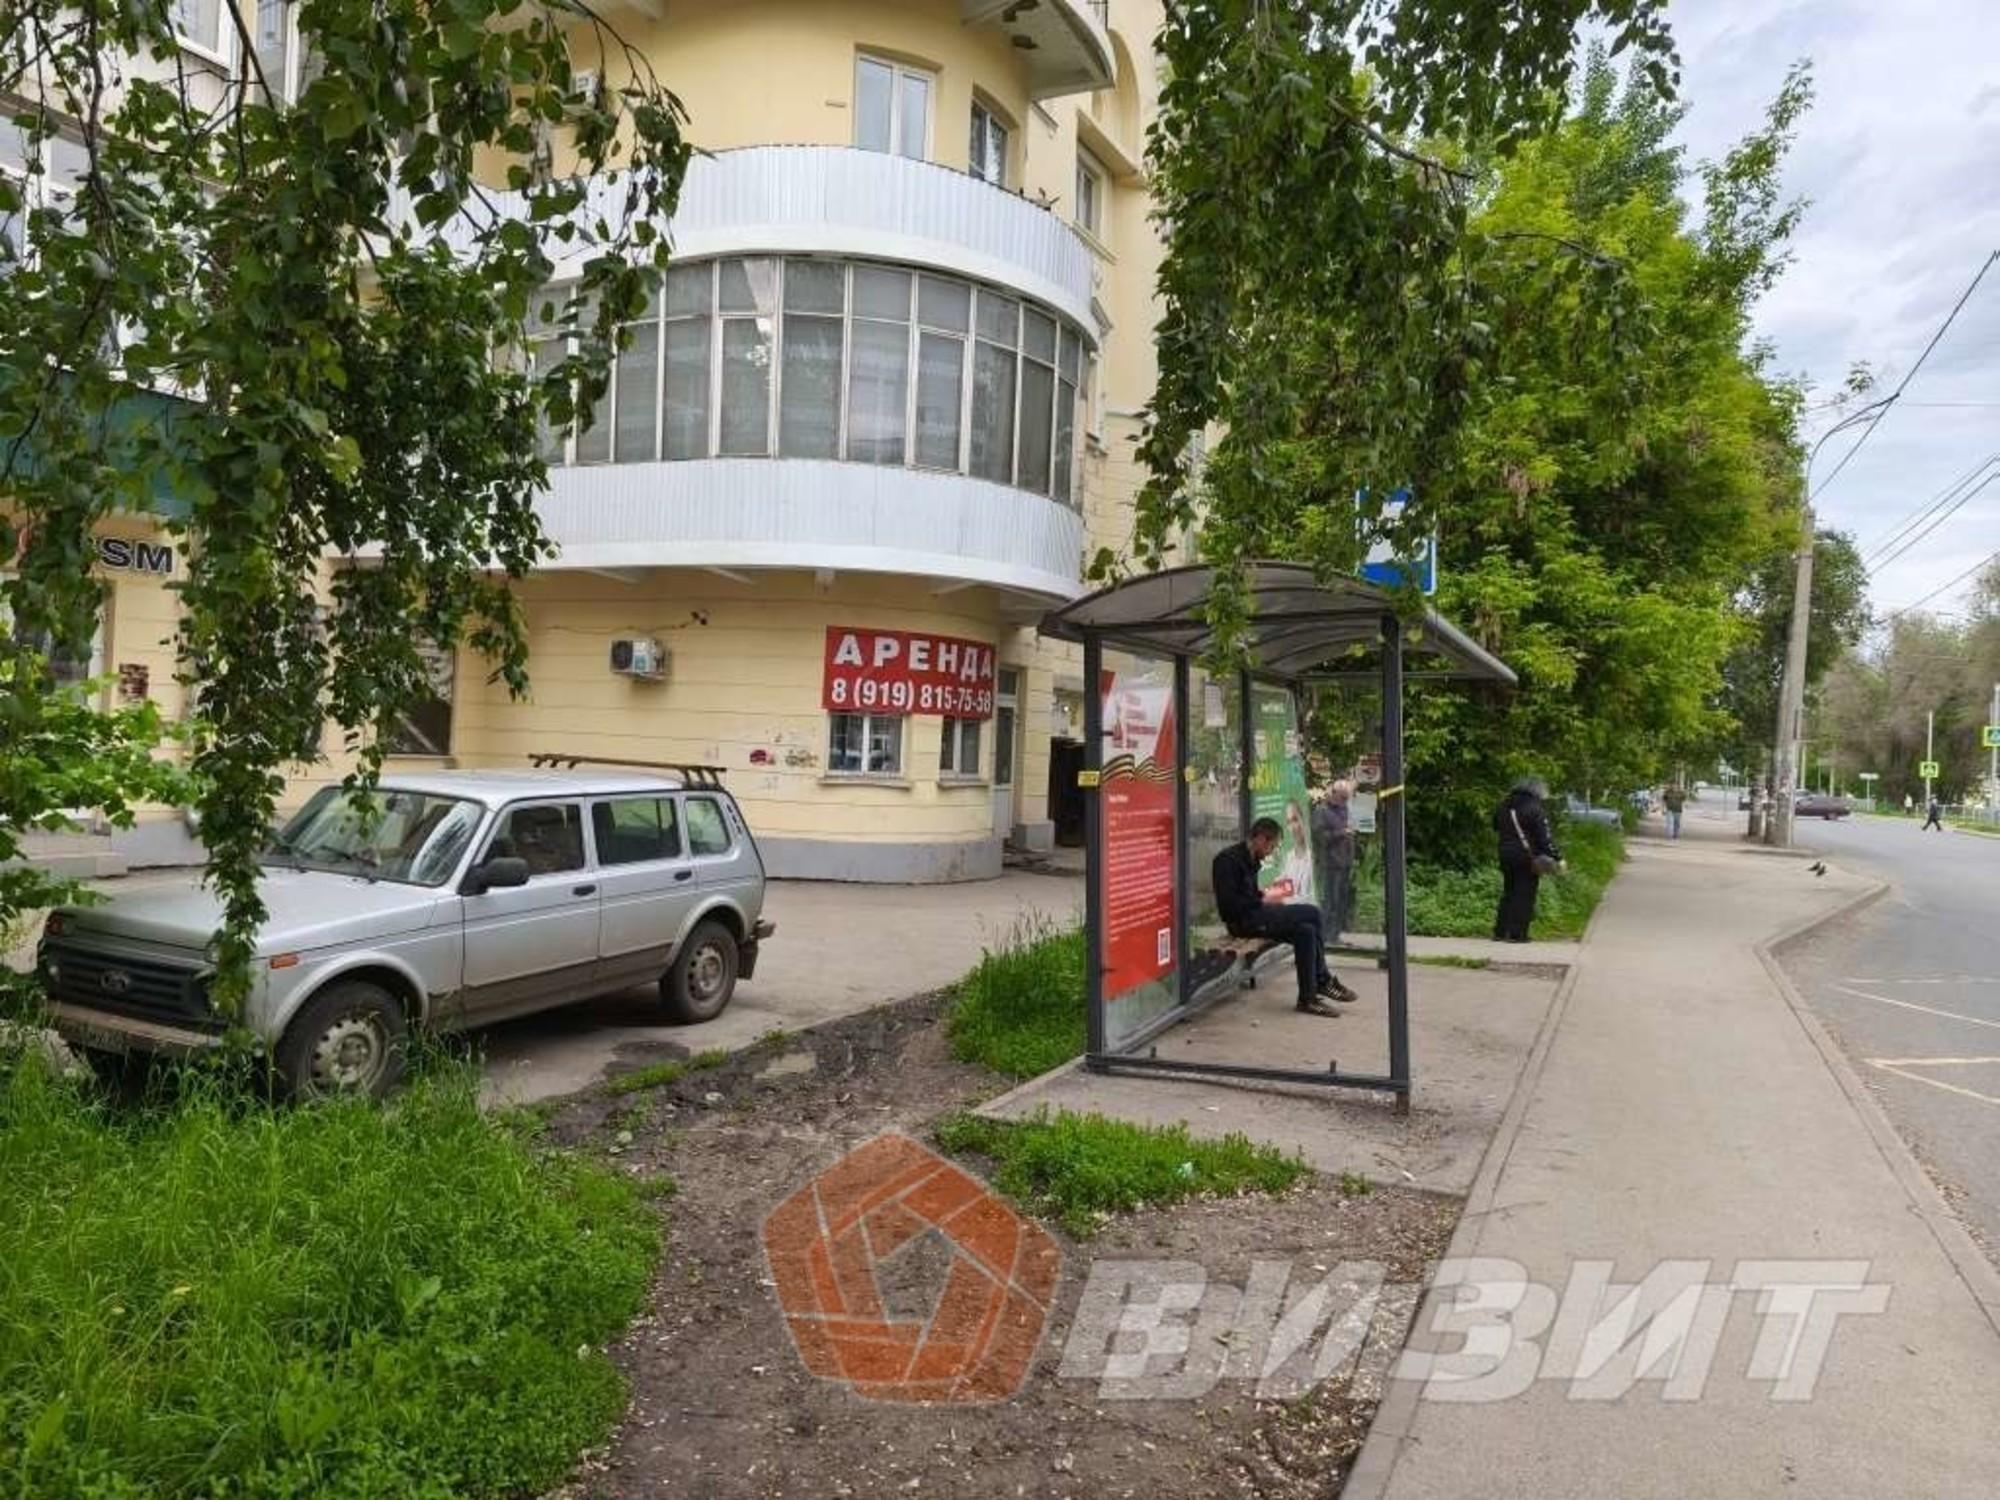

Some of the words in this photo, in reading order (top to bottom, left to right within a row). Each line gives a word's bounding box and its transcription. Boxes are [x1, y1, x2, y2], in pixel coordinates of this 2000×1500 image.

[97, 538, 173, 574] SM
[832, 633, 992, 682] АРЕНДА
[831, 677, 847, 704] 8
[853, 676, 915, 711] (919)
[920, 683, 992, 714] 815-75-58
